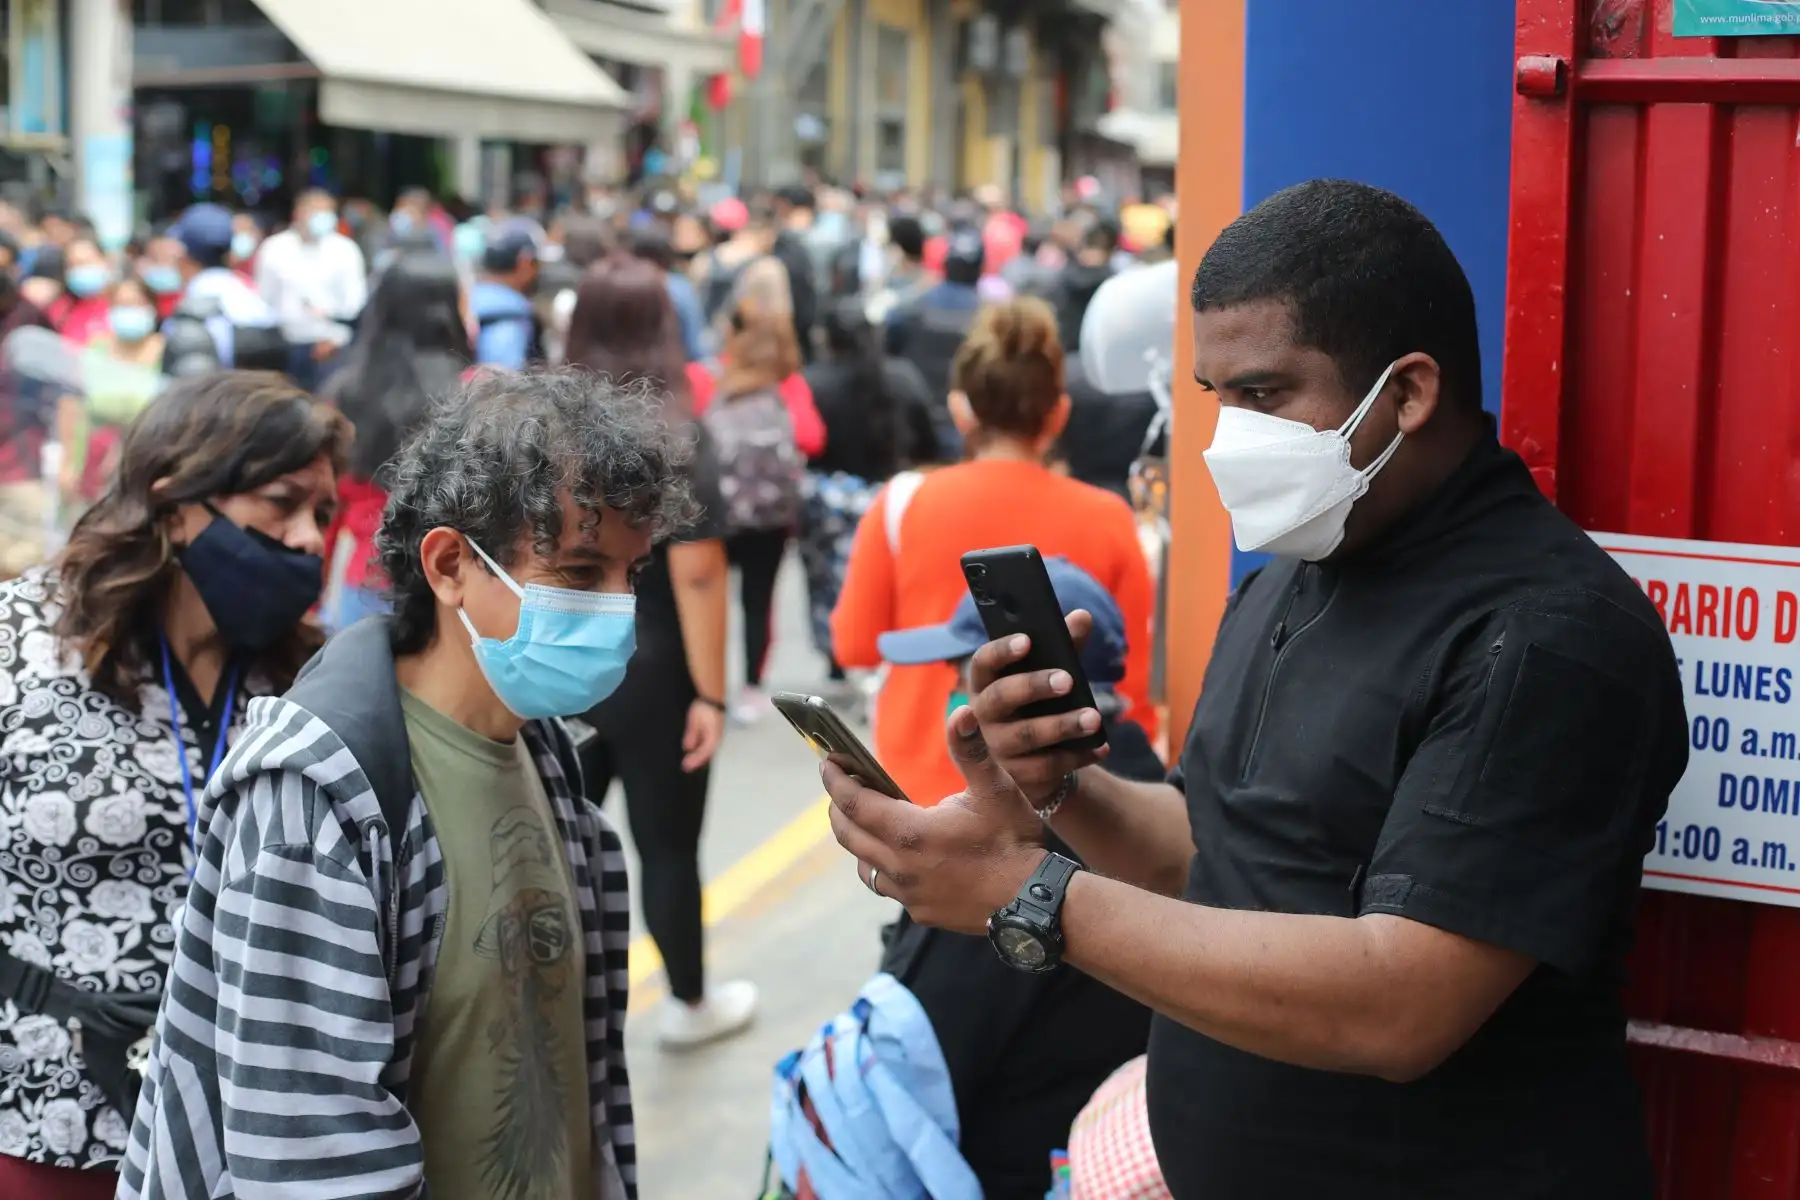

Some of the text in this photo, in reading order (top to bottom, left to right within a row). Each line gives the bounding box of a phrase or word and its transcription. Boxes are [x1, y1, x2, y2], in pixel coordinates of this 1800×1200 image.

[1631, 577, 1799, 644] RARIO D
[1695, 660, 1792, 704] LUNES
[1692, 715, 1730, 752] 00
[1718, 772, 1800, 816] DOMI
[1731, 838, 1796, 871] a.m.
